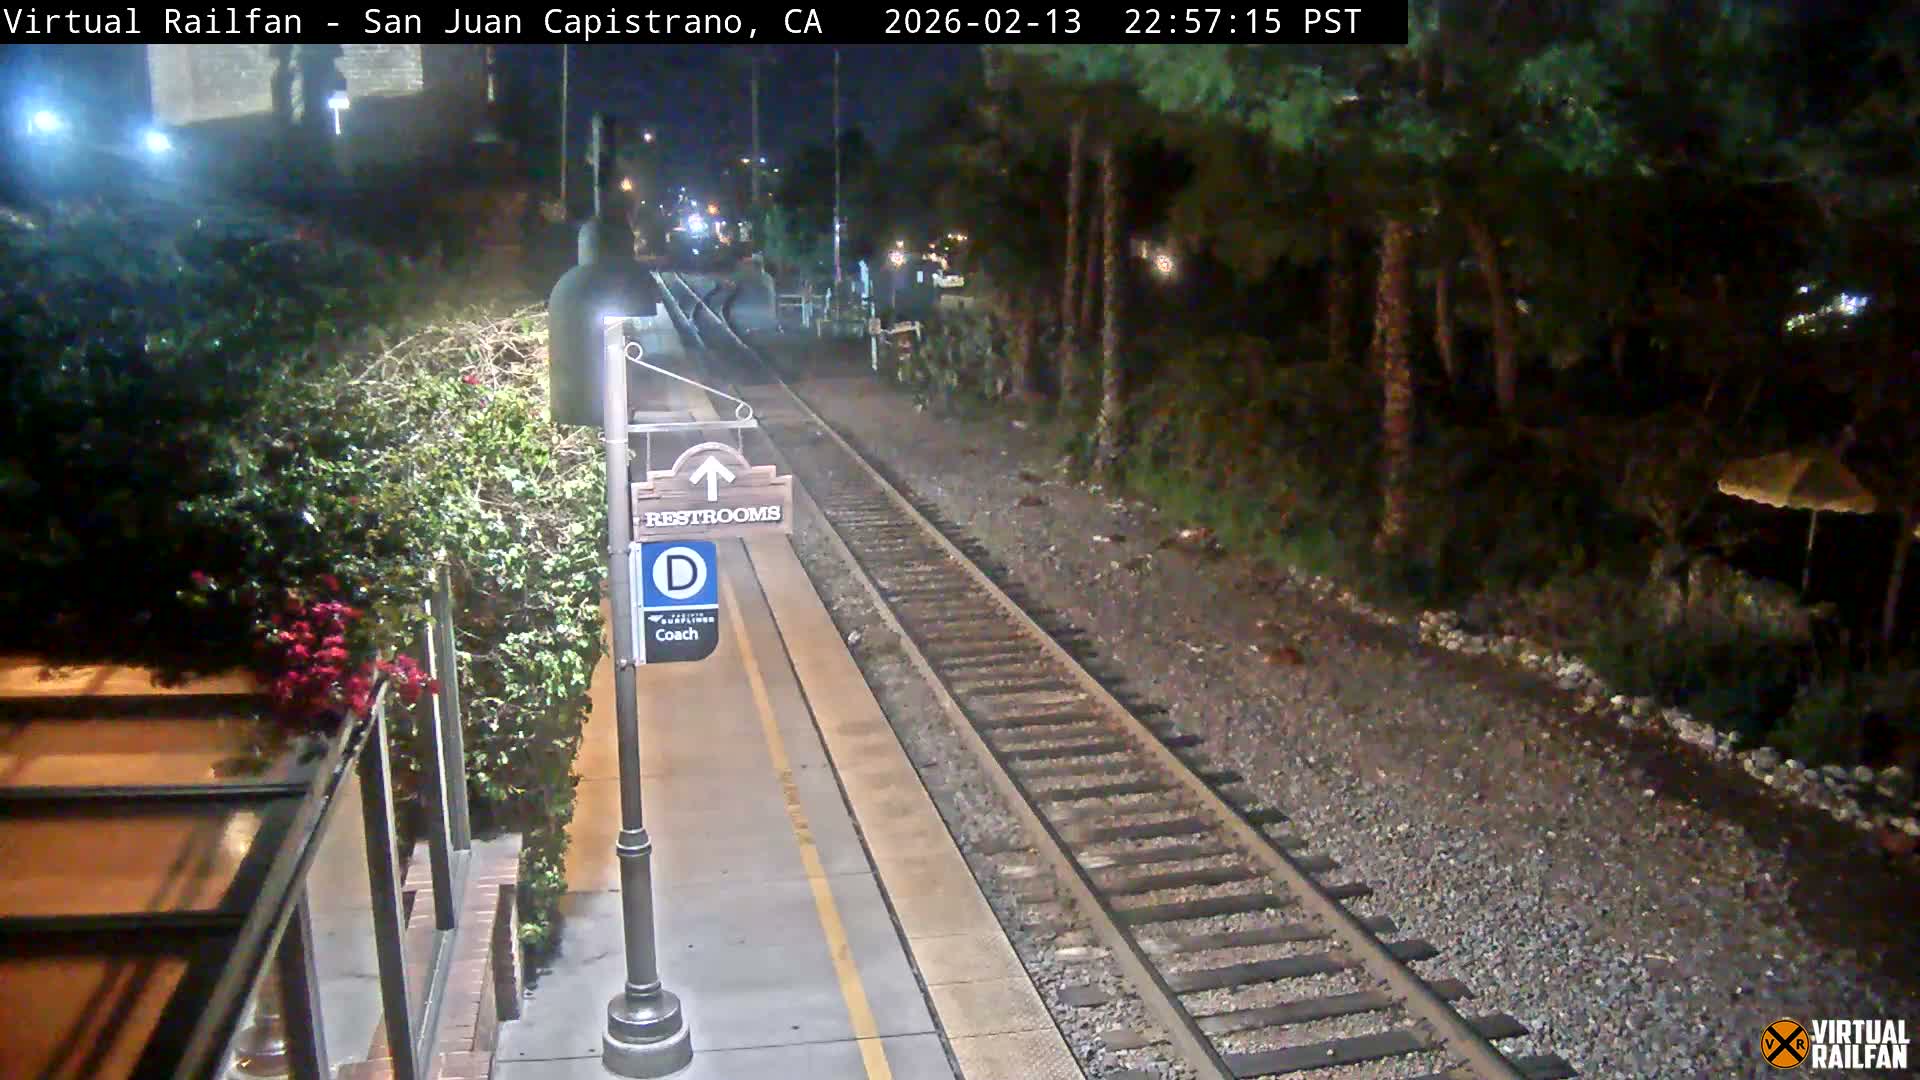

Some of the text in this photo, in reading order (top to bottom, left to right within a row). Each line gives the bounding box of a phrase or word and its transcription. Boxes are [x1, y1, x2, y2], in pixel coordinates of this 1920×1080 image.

[645, 505, 781, 527] RESTROOMS
[666, 554, 698, 591] D
[655, 627, 699, 641] Coach
